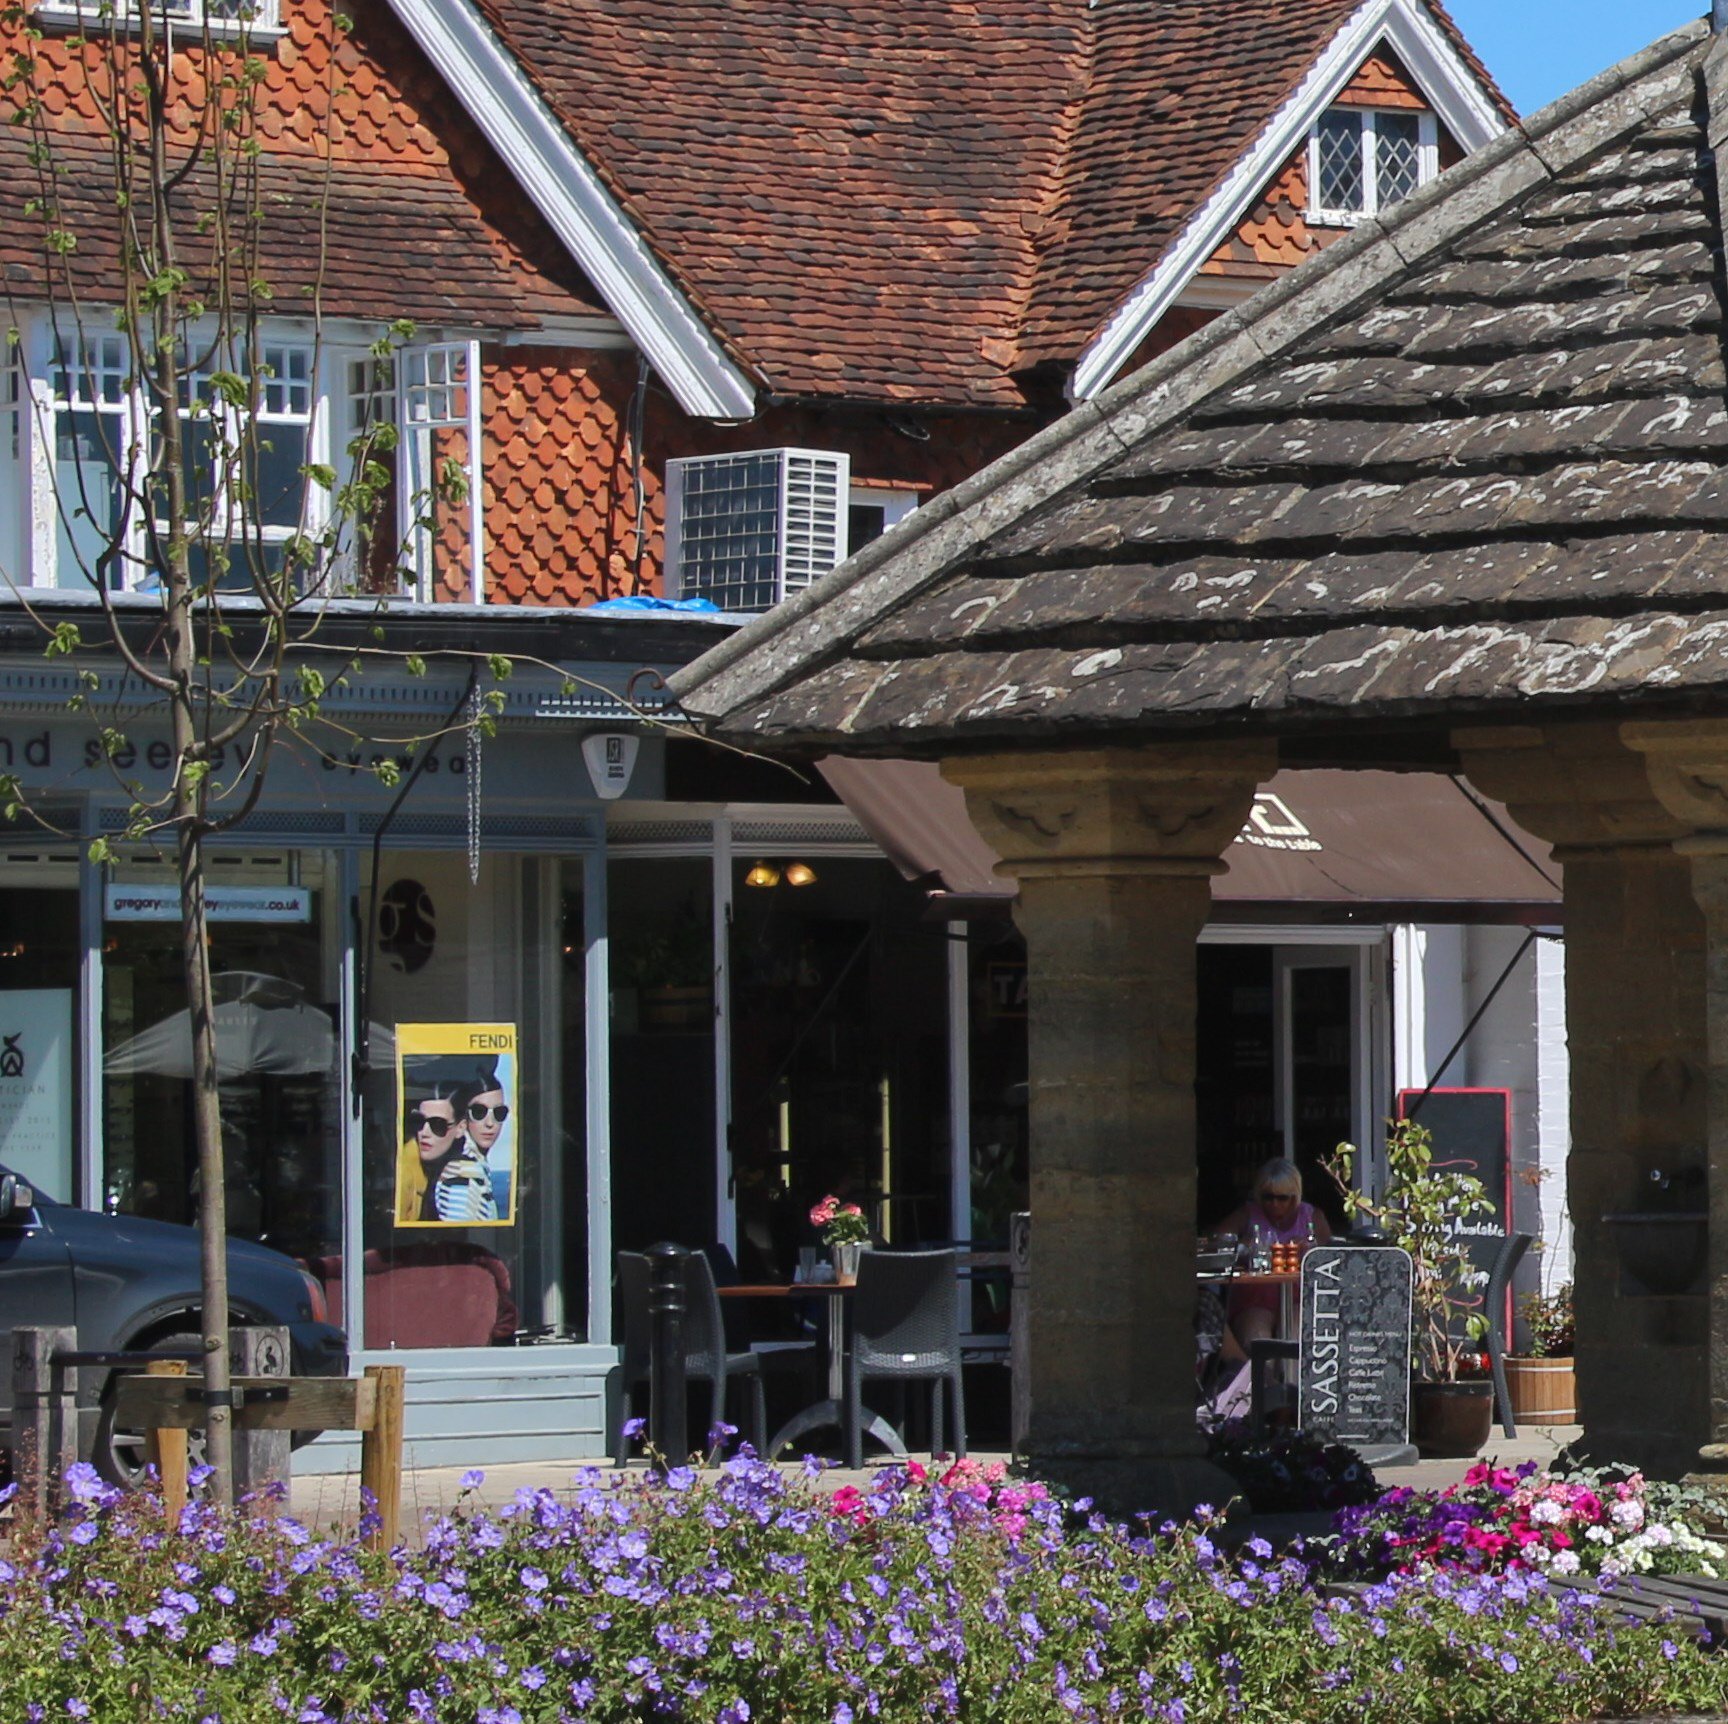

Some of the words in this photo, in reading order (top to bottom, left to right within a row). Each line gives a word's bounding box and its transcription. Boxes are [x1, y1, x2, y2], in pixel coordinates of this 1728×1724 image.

[469, 1034, 513, 1050] FENDI
[1454, 1216, 1506, 1238] Available
[1312, 1258, 1341, 1414] SASSETTA
